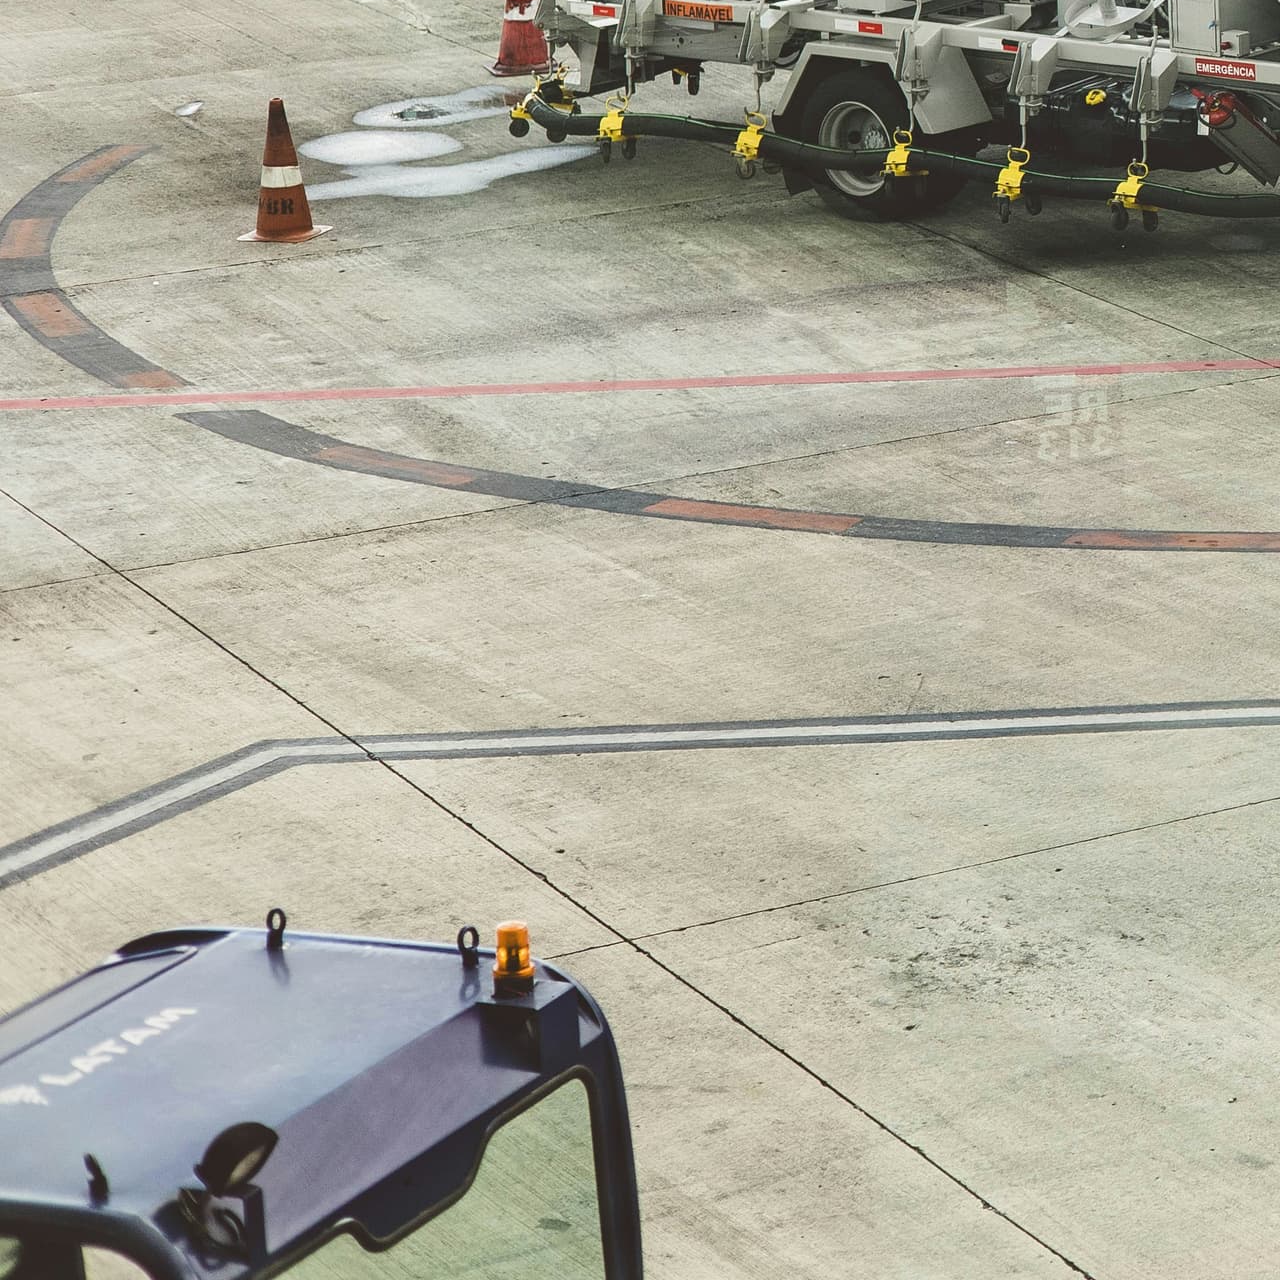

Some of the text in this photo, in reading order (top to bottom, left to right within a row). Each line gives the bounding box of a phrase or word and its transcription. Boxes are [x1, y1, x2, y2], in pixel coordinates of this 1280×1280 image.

[666, 1, 733, 21] INFLAMÁVEL
[1196, 62, 1255, 78] EMERGÊNCIA
[38, 1007, 198, 1087] LATAM
